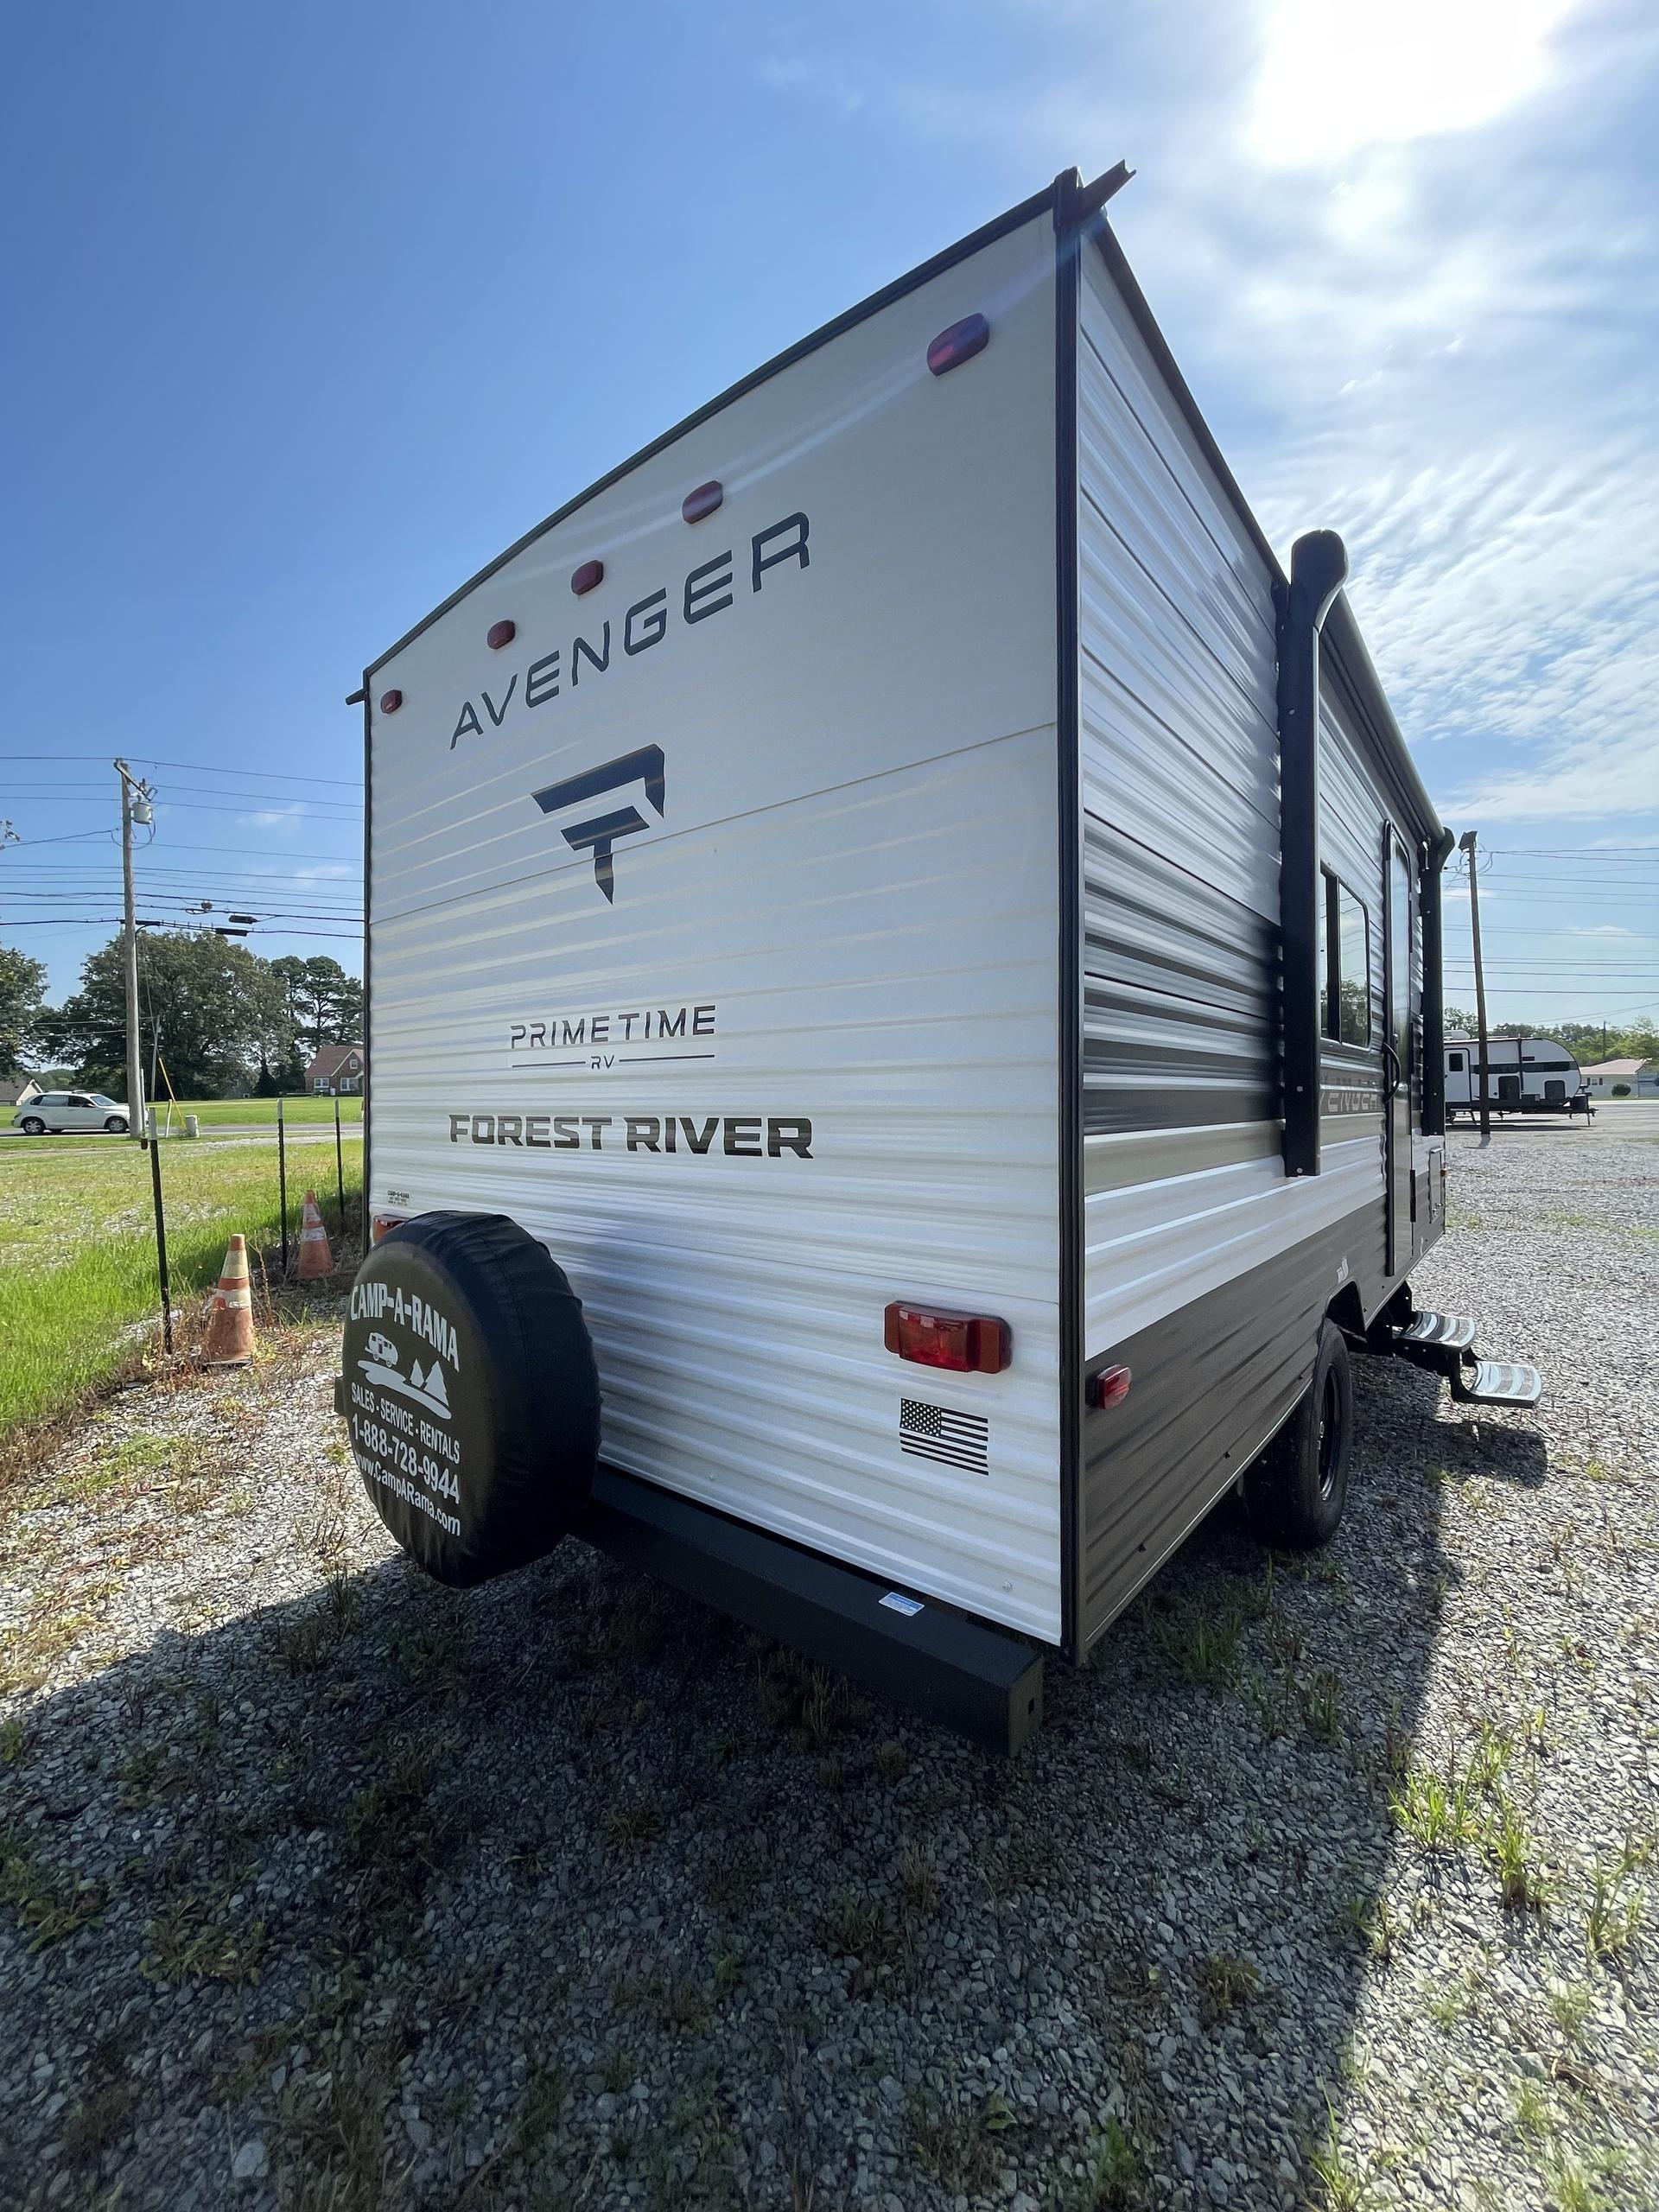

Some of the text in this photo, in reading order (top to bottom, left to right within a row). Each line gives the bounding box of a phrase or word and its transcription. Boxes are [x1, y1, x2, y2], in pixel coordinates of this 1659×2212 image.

[450, 512, 810, 750] AVENGER
[591, 1055, 614, 1070] RV
[448, 1115, 814, 1159] FOREST RIVER
[350, 1283, 460, 1372] CAMP-A-RAMA
[352, 1382, 375, 1413] SALES
[380, 1398, 414, 1437] SERVICE
[420, 1420, 461, 1465] RENTALS
[352, 1414, 461, 1504] 1-888-728-9944
